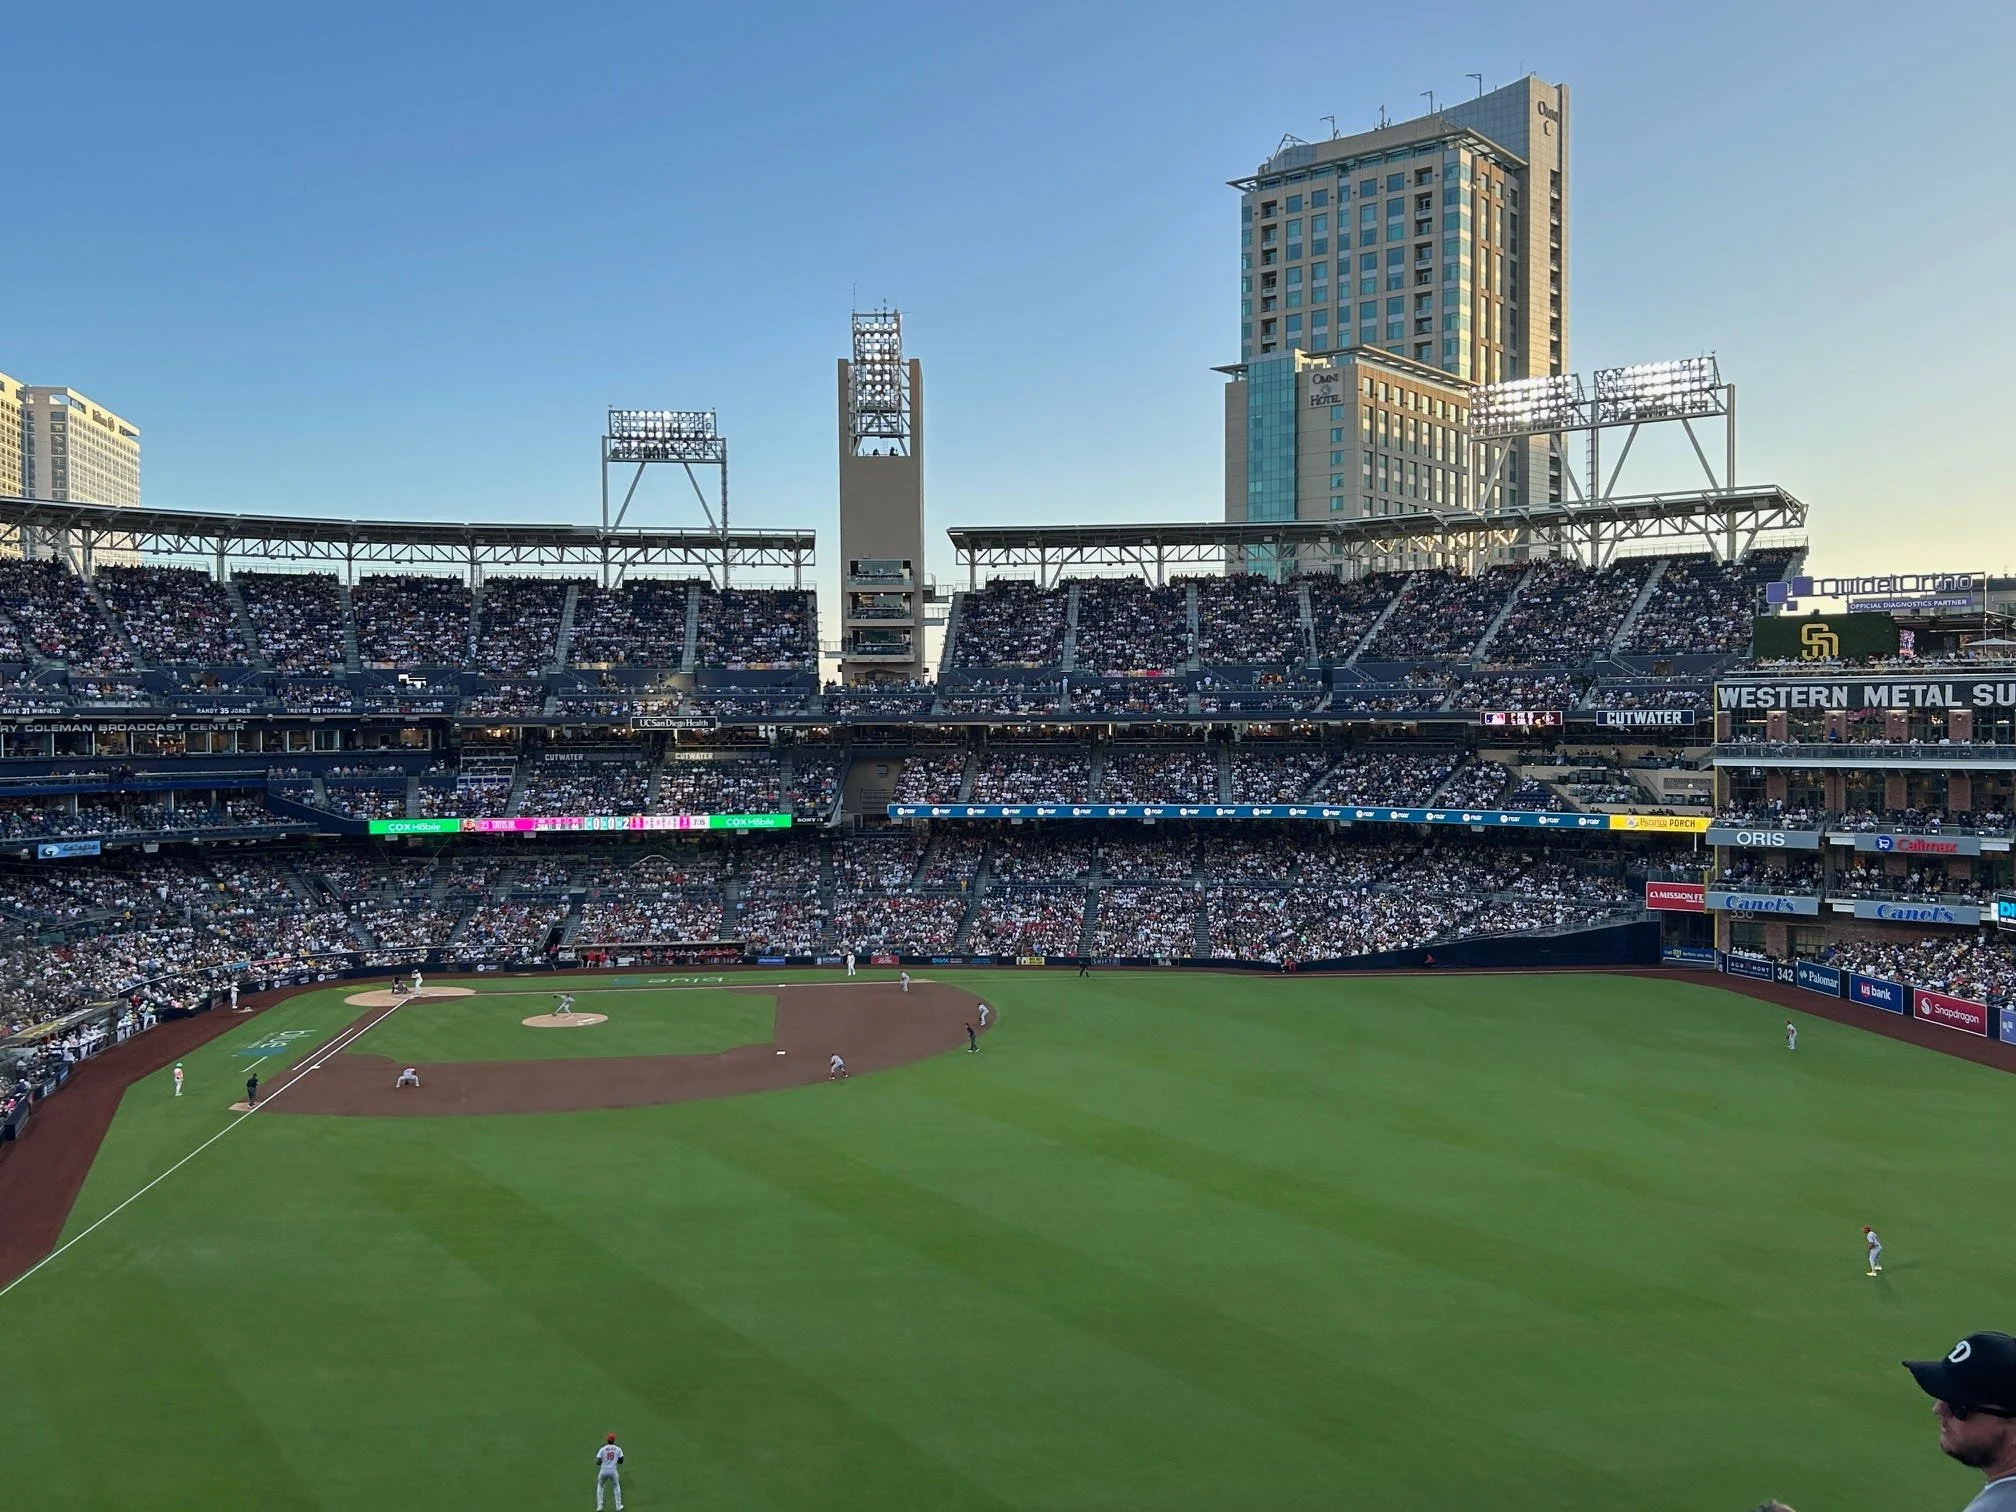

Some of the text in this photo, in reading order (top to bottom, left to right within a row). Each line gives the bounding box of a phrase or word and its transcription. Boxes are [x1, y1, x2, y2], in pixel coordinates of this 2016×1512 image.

[1310, 394, 1341, 406] HOTEL
[1820, 573, 1973, 599] QuidelOrtho
[1883, 601, 1932, 609] DIAGNOSTICS
[1934, 599, 1967, 607] PARTNER
[1718, 685, 1848, 708] WESTERN
[1863, 685, 1963, 707] METAL
[640, 719, 708, 728] UC San Diego Health
[1607, 712, 1681, 724] CUTWATER
[25, 724, 92, 732] COLEMAN
[98, 723, 184, 732] BROADCAST
[190, 723, 245, 731] CENTER
[675, 752, 713, 760] CUTWATER
[1670, 819, 1695, 828] PORCH
[1736, 832, 1785, 846] ORIS
[1659, 892, 1693, 900] MISSION
[1777, 967, 1794, 982] 342
[1809, 970, 1838, 988] Palomar
[1861, 985, 1891, 1000] us bank
[1934, 1003, 1979, 1023] Snapdragon
